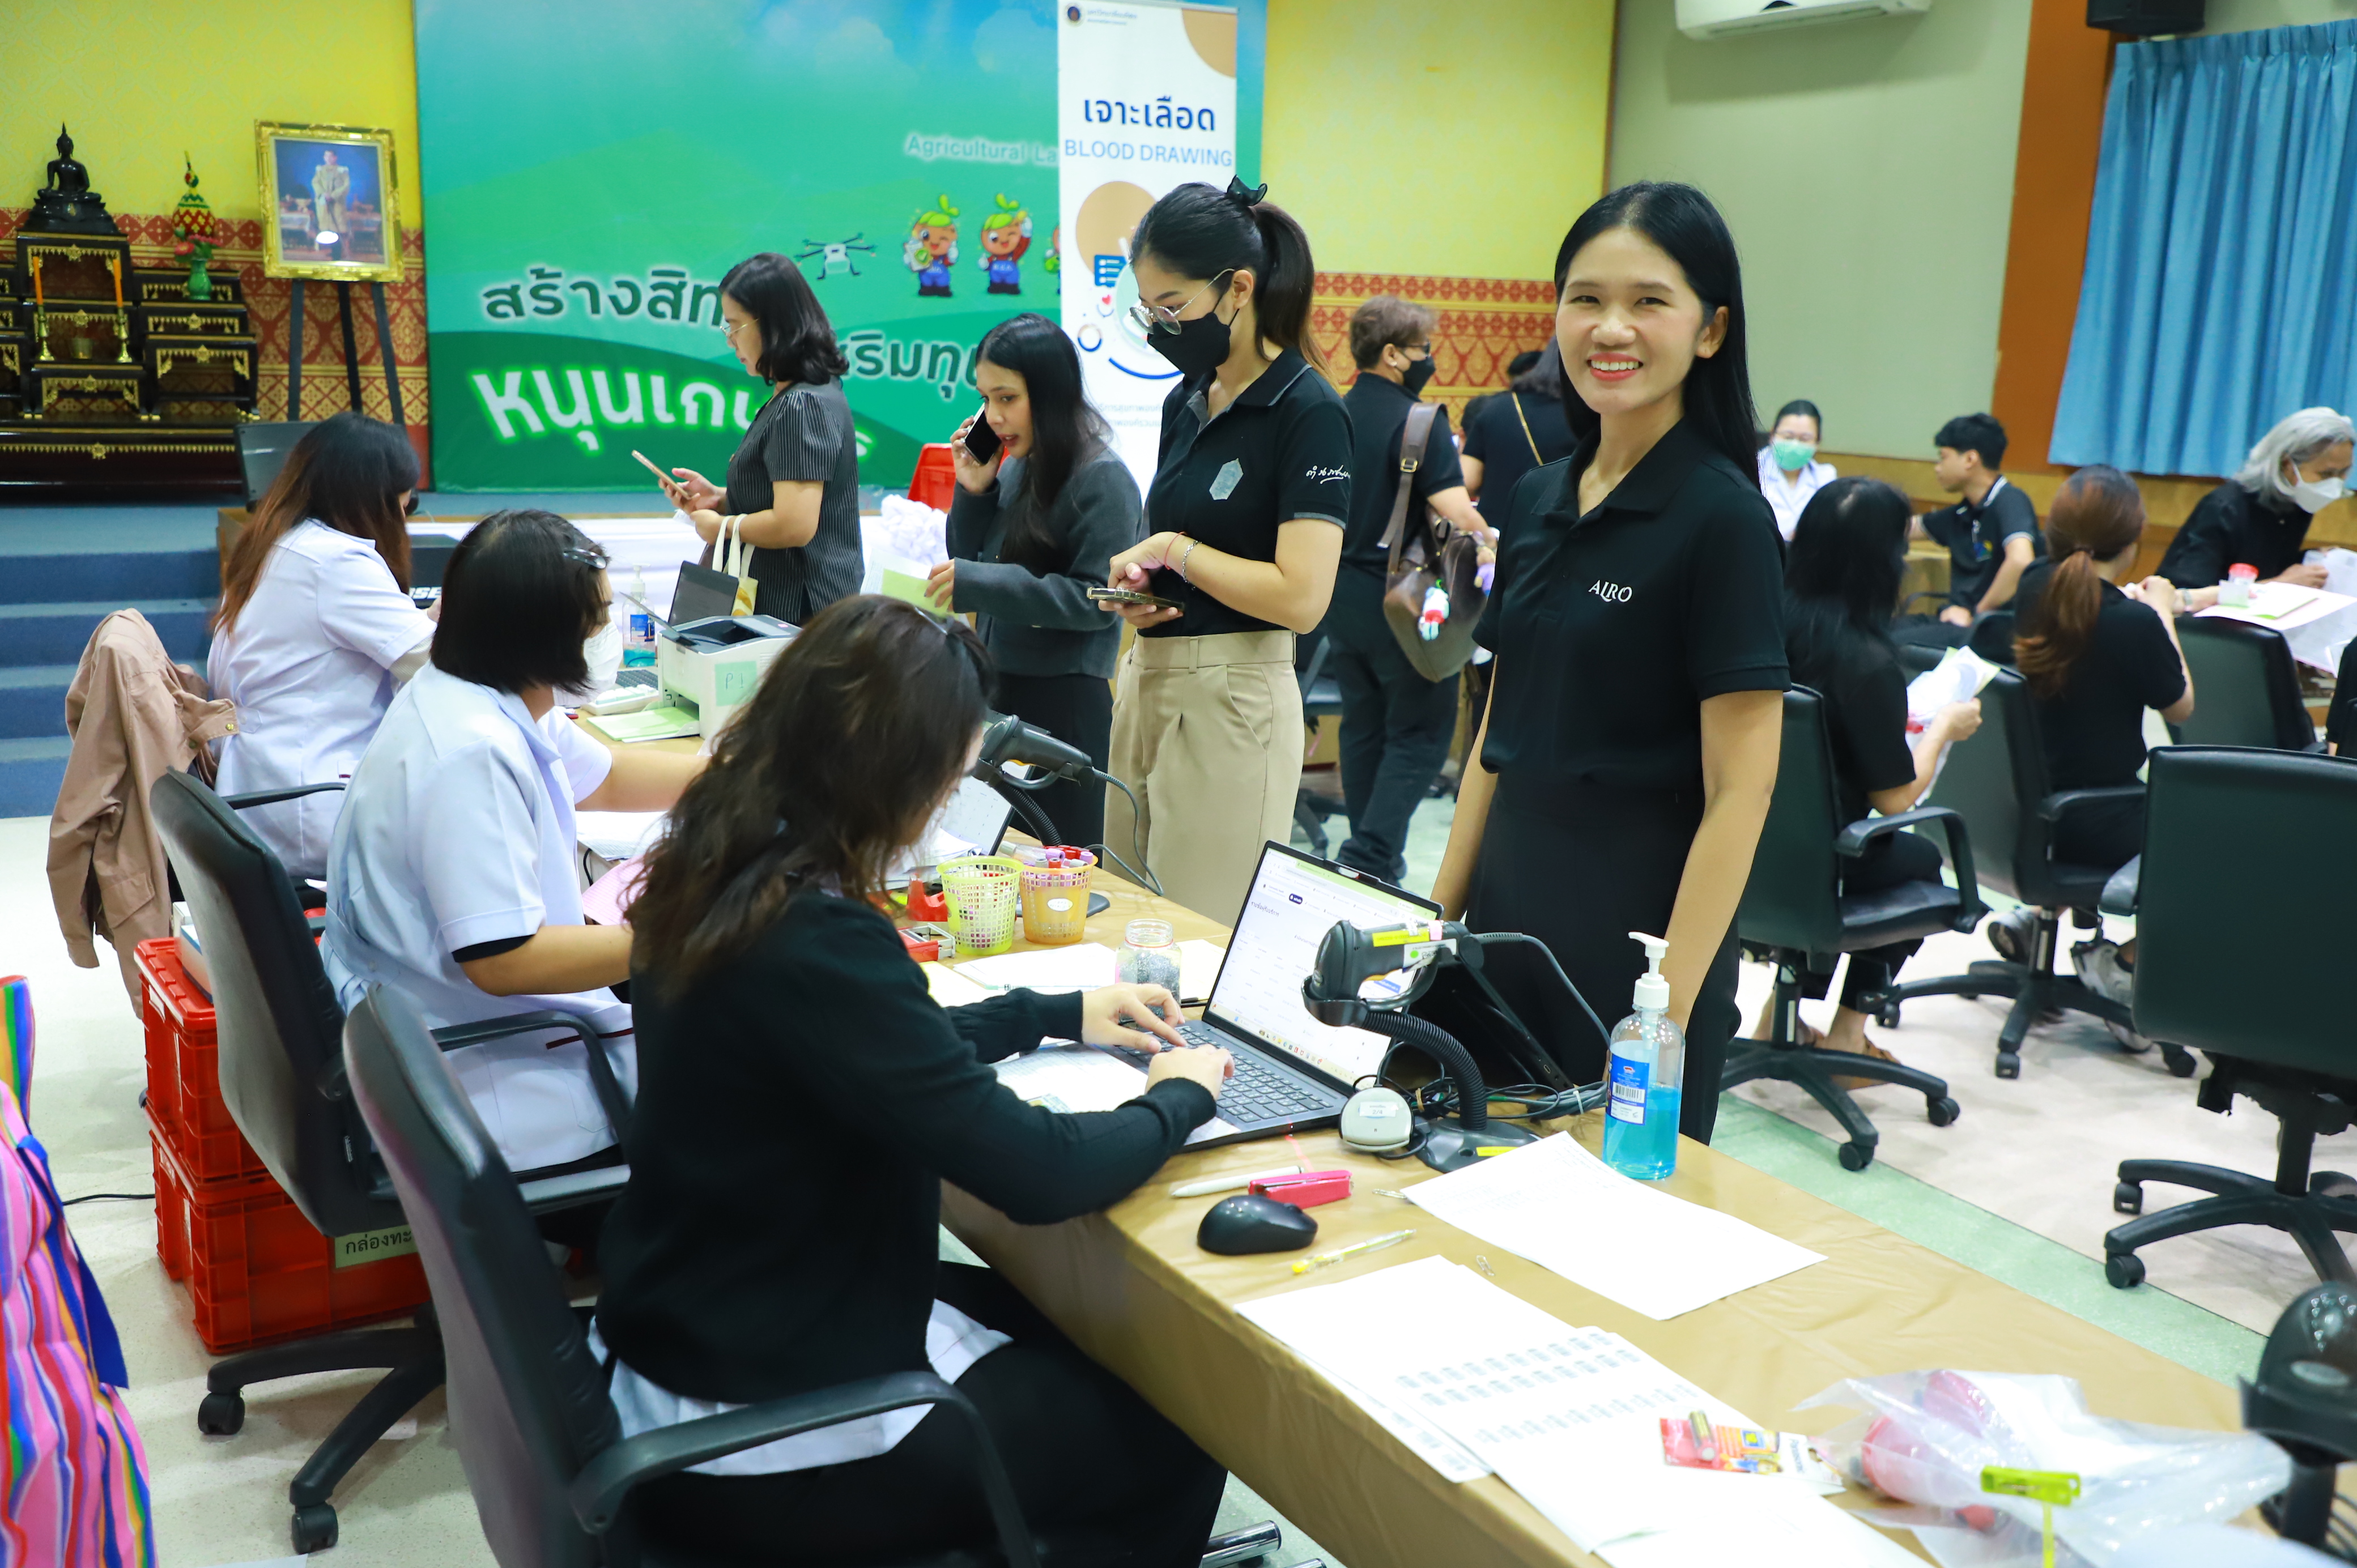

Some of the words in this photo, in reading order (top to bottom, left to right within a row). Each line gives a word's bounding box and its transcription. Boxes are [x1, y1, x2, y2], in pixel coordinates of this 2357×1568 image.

[1084, 95, 1215, 131] เจาะเลือด
[908, 135, 1025, 160] Agricultural
[1065, 139, 1135, 161] BLOOD
[1141, 145, 1233, 167] DRAWING
[1588, 580, 1632, 602] ALRO
